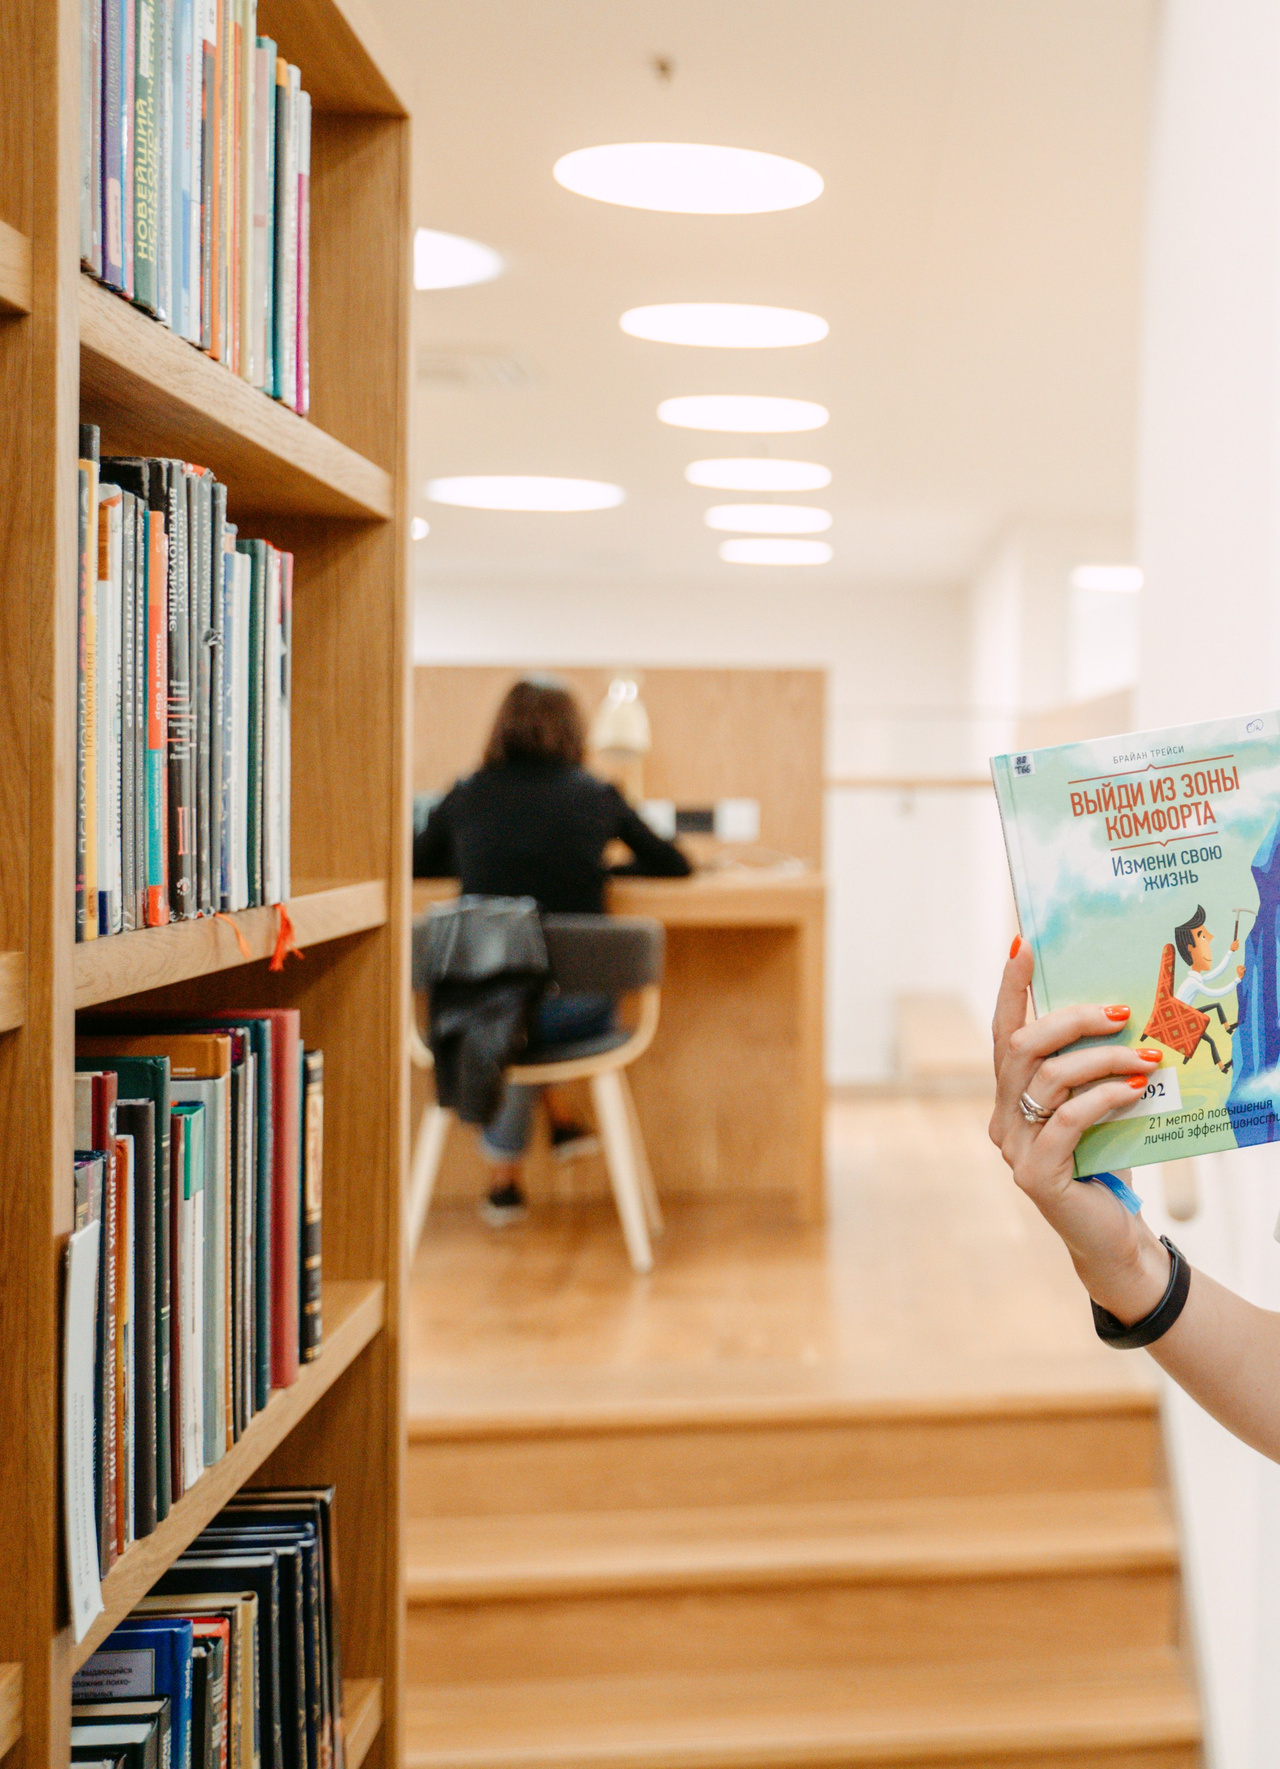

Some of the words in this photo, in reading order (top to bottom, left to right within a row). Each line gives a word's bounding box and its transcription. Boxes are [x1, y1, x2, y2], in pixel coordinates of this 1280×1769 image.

[136, 97, 149, 260] НОВЕЙШИЙ
[168, 487, 178, 632] ЭНЦИКЛОПЕДИЯ
[1112, 751, 1148, 765] БРАЙАН
[1150, 745, 1185, 758] ТРЕЙСИ
[1070, 781, 1146, 817] ВЫЙДИ
[1150, 775, 1177, 804] ИЗ
[1181, 765, 1241, 797] ЗОНЫ
[1105, 800, 1217, 841] КОМФОРТА
[1112, 852, 1178, 877] Измени
[1181, 844, 1223, 865] свою
[1143, 869, 1199, 892] жизнь
[1149, 1117, 1162, 1130] 21
[1166, 1109, 1205, 1127] метод
[1207, 1099, 1273, 1121] повышения
[1144, 1127, 1185, 1146] личной
